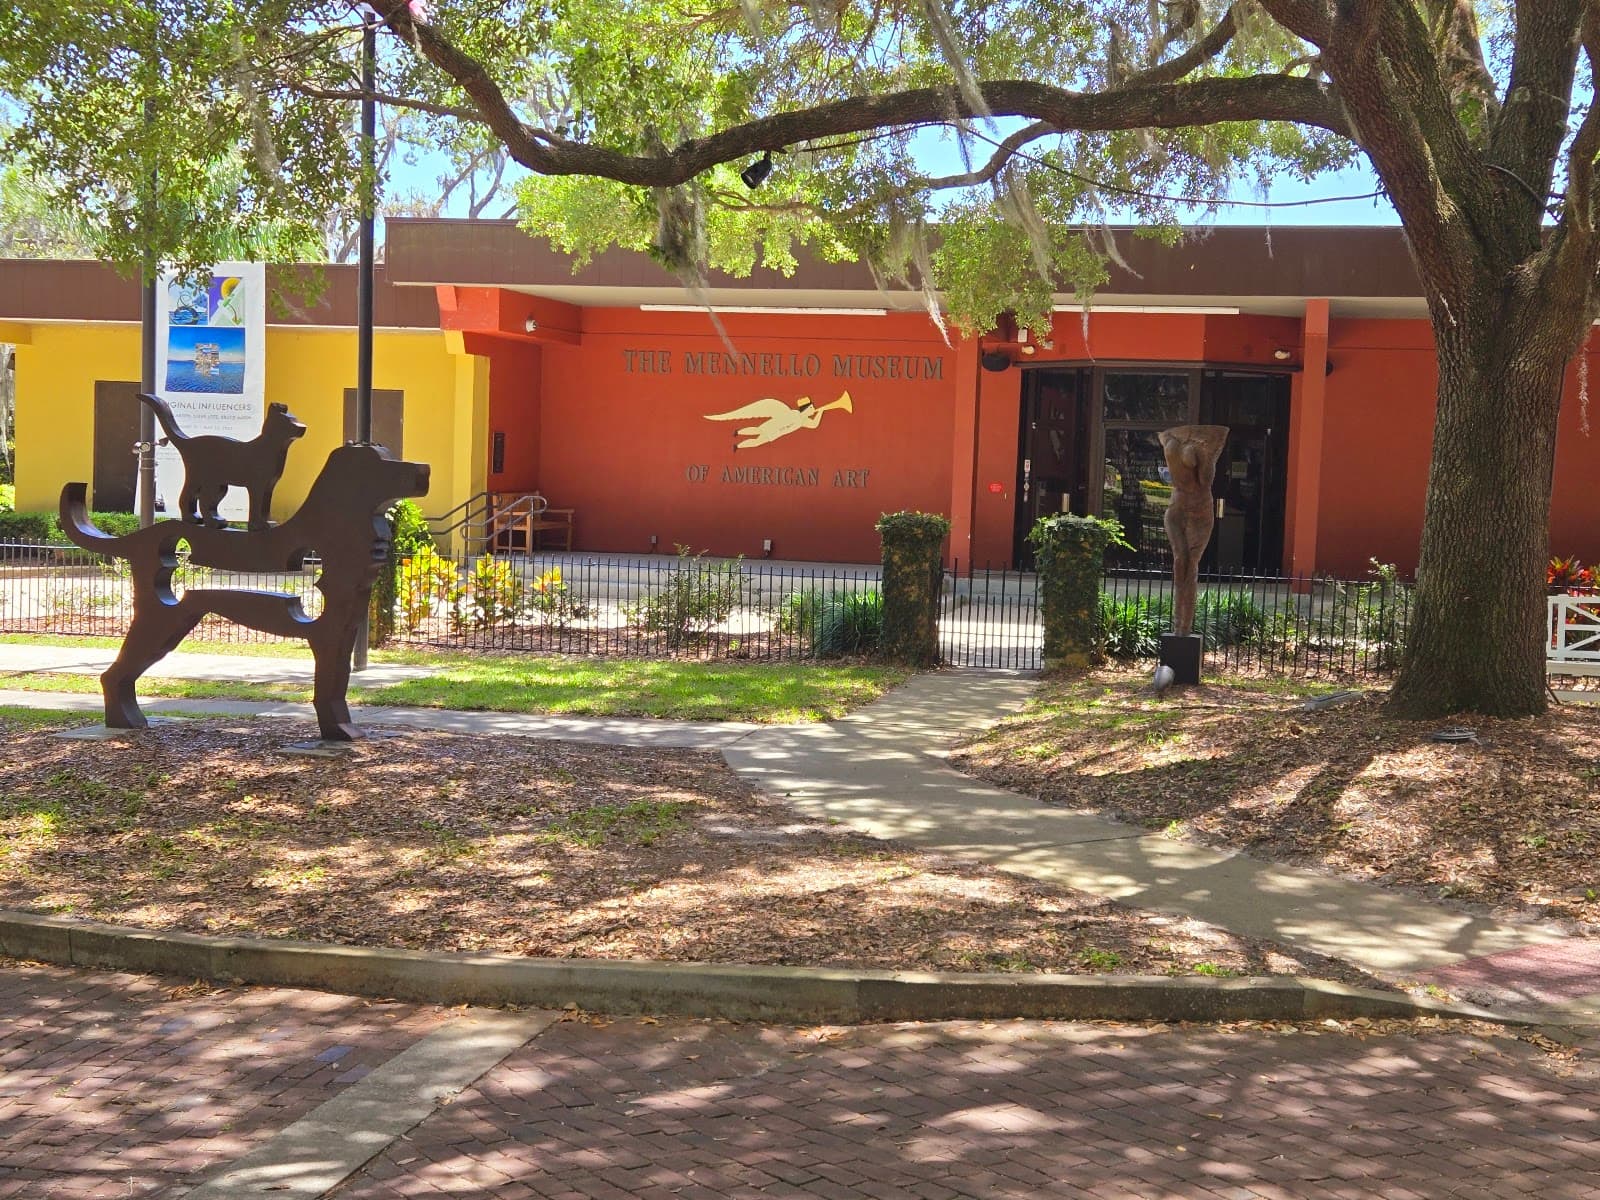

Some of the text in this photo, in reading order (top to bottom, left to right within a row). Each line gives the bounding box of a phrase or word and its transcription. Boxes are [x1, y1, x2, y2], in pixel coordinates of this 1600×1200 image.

[623, 349, 944, 380] THE MENNELLO MUSEUM
[198, 401, 252, 411] INFLUENCERS
[686, 464, 870, 489] OF AMERICAN ART
